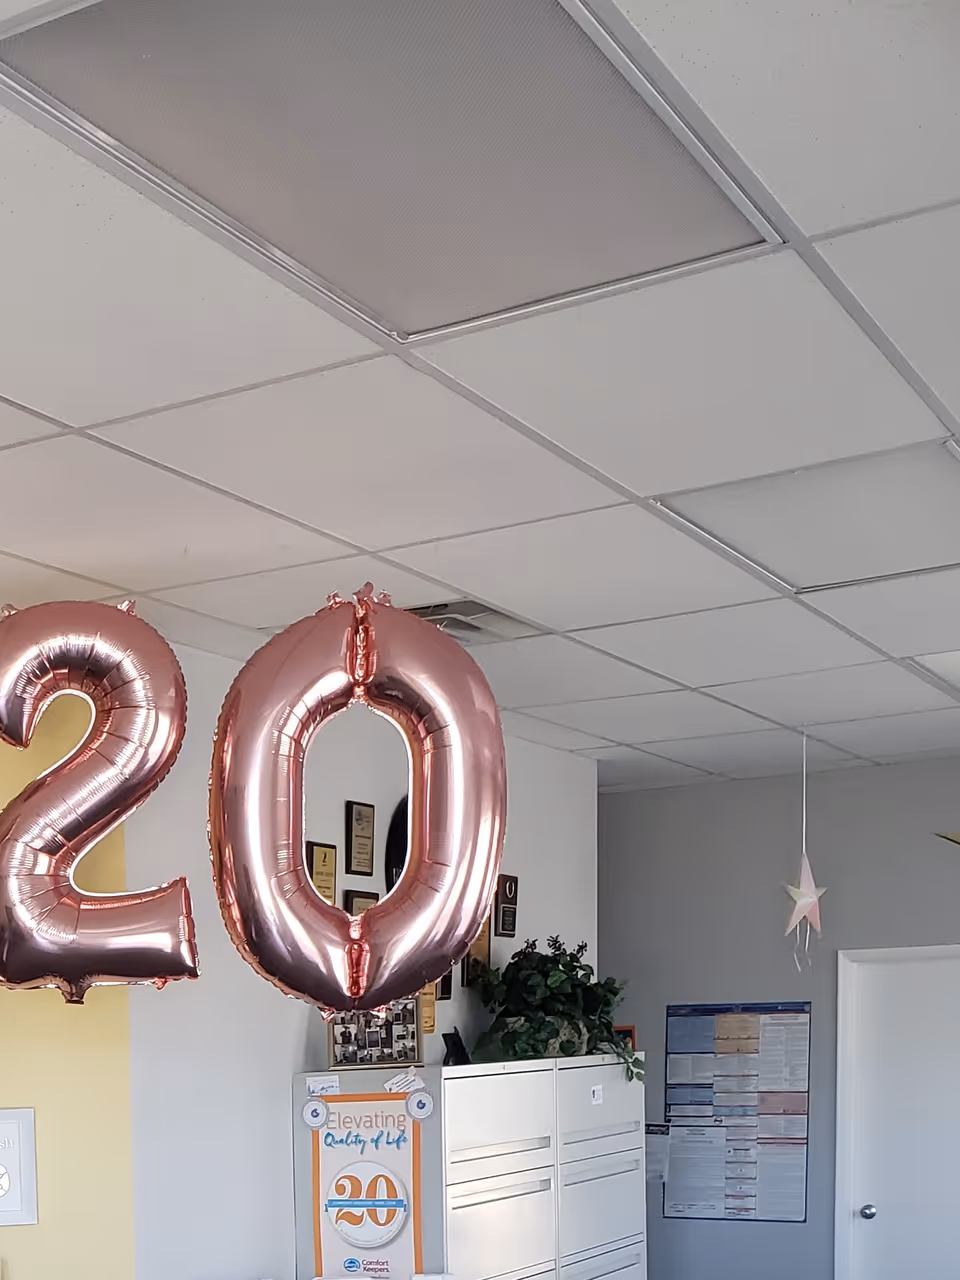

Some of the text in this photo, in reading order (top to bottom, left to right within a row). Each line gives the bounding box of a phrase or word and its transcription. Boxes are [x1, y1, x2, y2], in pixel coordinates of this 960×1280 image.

[326, 1111, 407, 1132] Elevating
[324, 1130, 408, 1154] Quality of Life
[334, 1173, 399, 1227] 20
[361, 1259, 389, 1268] Comfort
